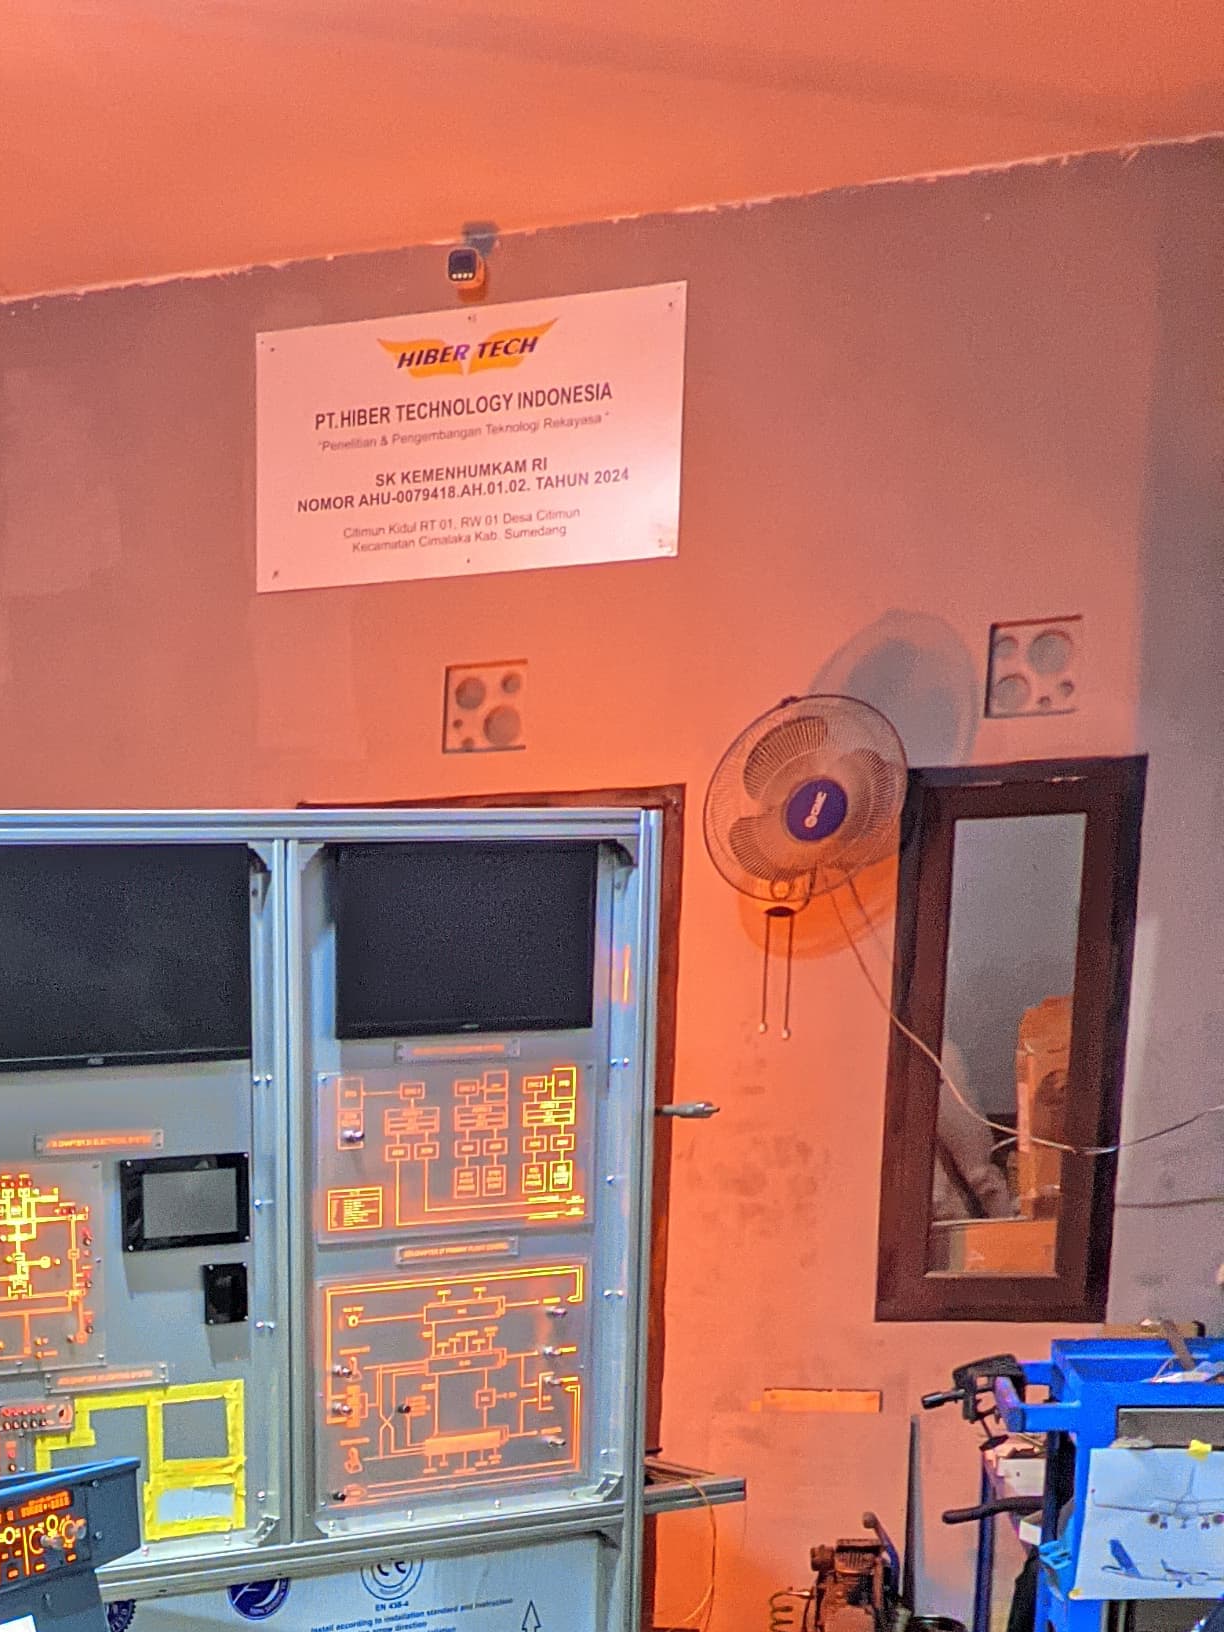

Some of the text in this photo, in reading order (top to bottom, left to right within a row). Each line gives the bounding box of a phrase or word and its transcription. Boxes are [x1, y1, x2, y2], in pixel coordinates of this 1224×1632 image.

[397, 336, 539, 368] HIBER TECH
[396, 393, 514, 421] TECHNOLOGY
[517, 382, 613, 409] INDONESIA
[380, 435, 389, 446] &
[392, 426, 482, 446] Pengembangan
[486, 418, 539, 434] Teknologi
[375, 457, 548, 487] SK KEMENHUMKAM RI
[297, 496, 355, 512] NOMOR
[535, 472, 590, 491] TAHUN
[594, 467, 629, 485] 2024
[388, 522, 416, 535] Kidul
[420, 520, 436, 532] RT
[461, 516, 481, 529] RW
[485, 515, 499, 526] 01
[503, 512, 533, 525] Desa
[352, 538, 415, 553] Kecamatan
[418, 533, 471, 548] Cimalaka
[504, 524, 567, 542] Sumedang
[311, 1622, 334, 1632] Install
[336, 1618, 373, 1631] according
[375, 1616, 383, 1625] to
[384, 1610, 424, 1623] installation
[427, 1605, 458, 1616] standard
[375, 1603, 386, 1611] EN
[395, 1620, 428, 1632] direction
